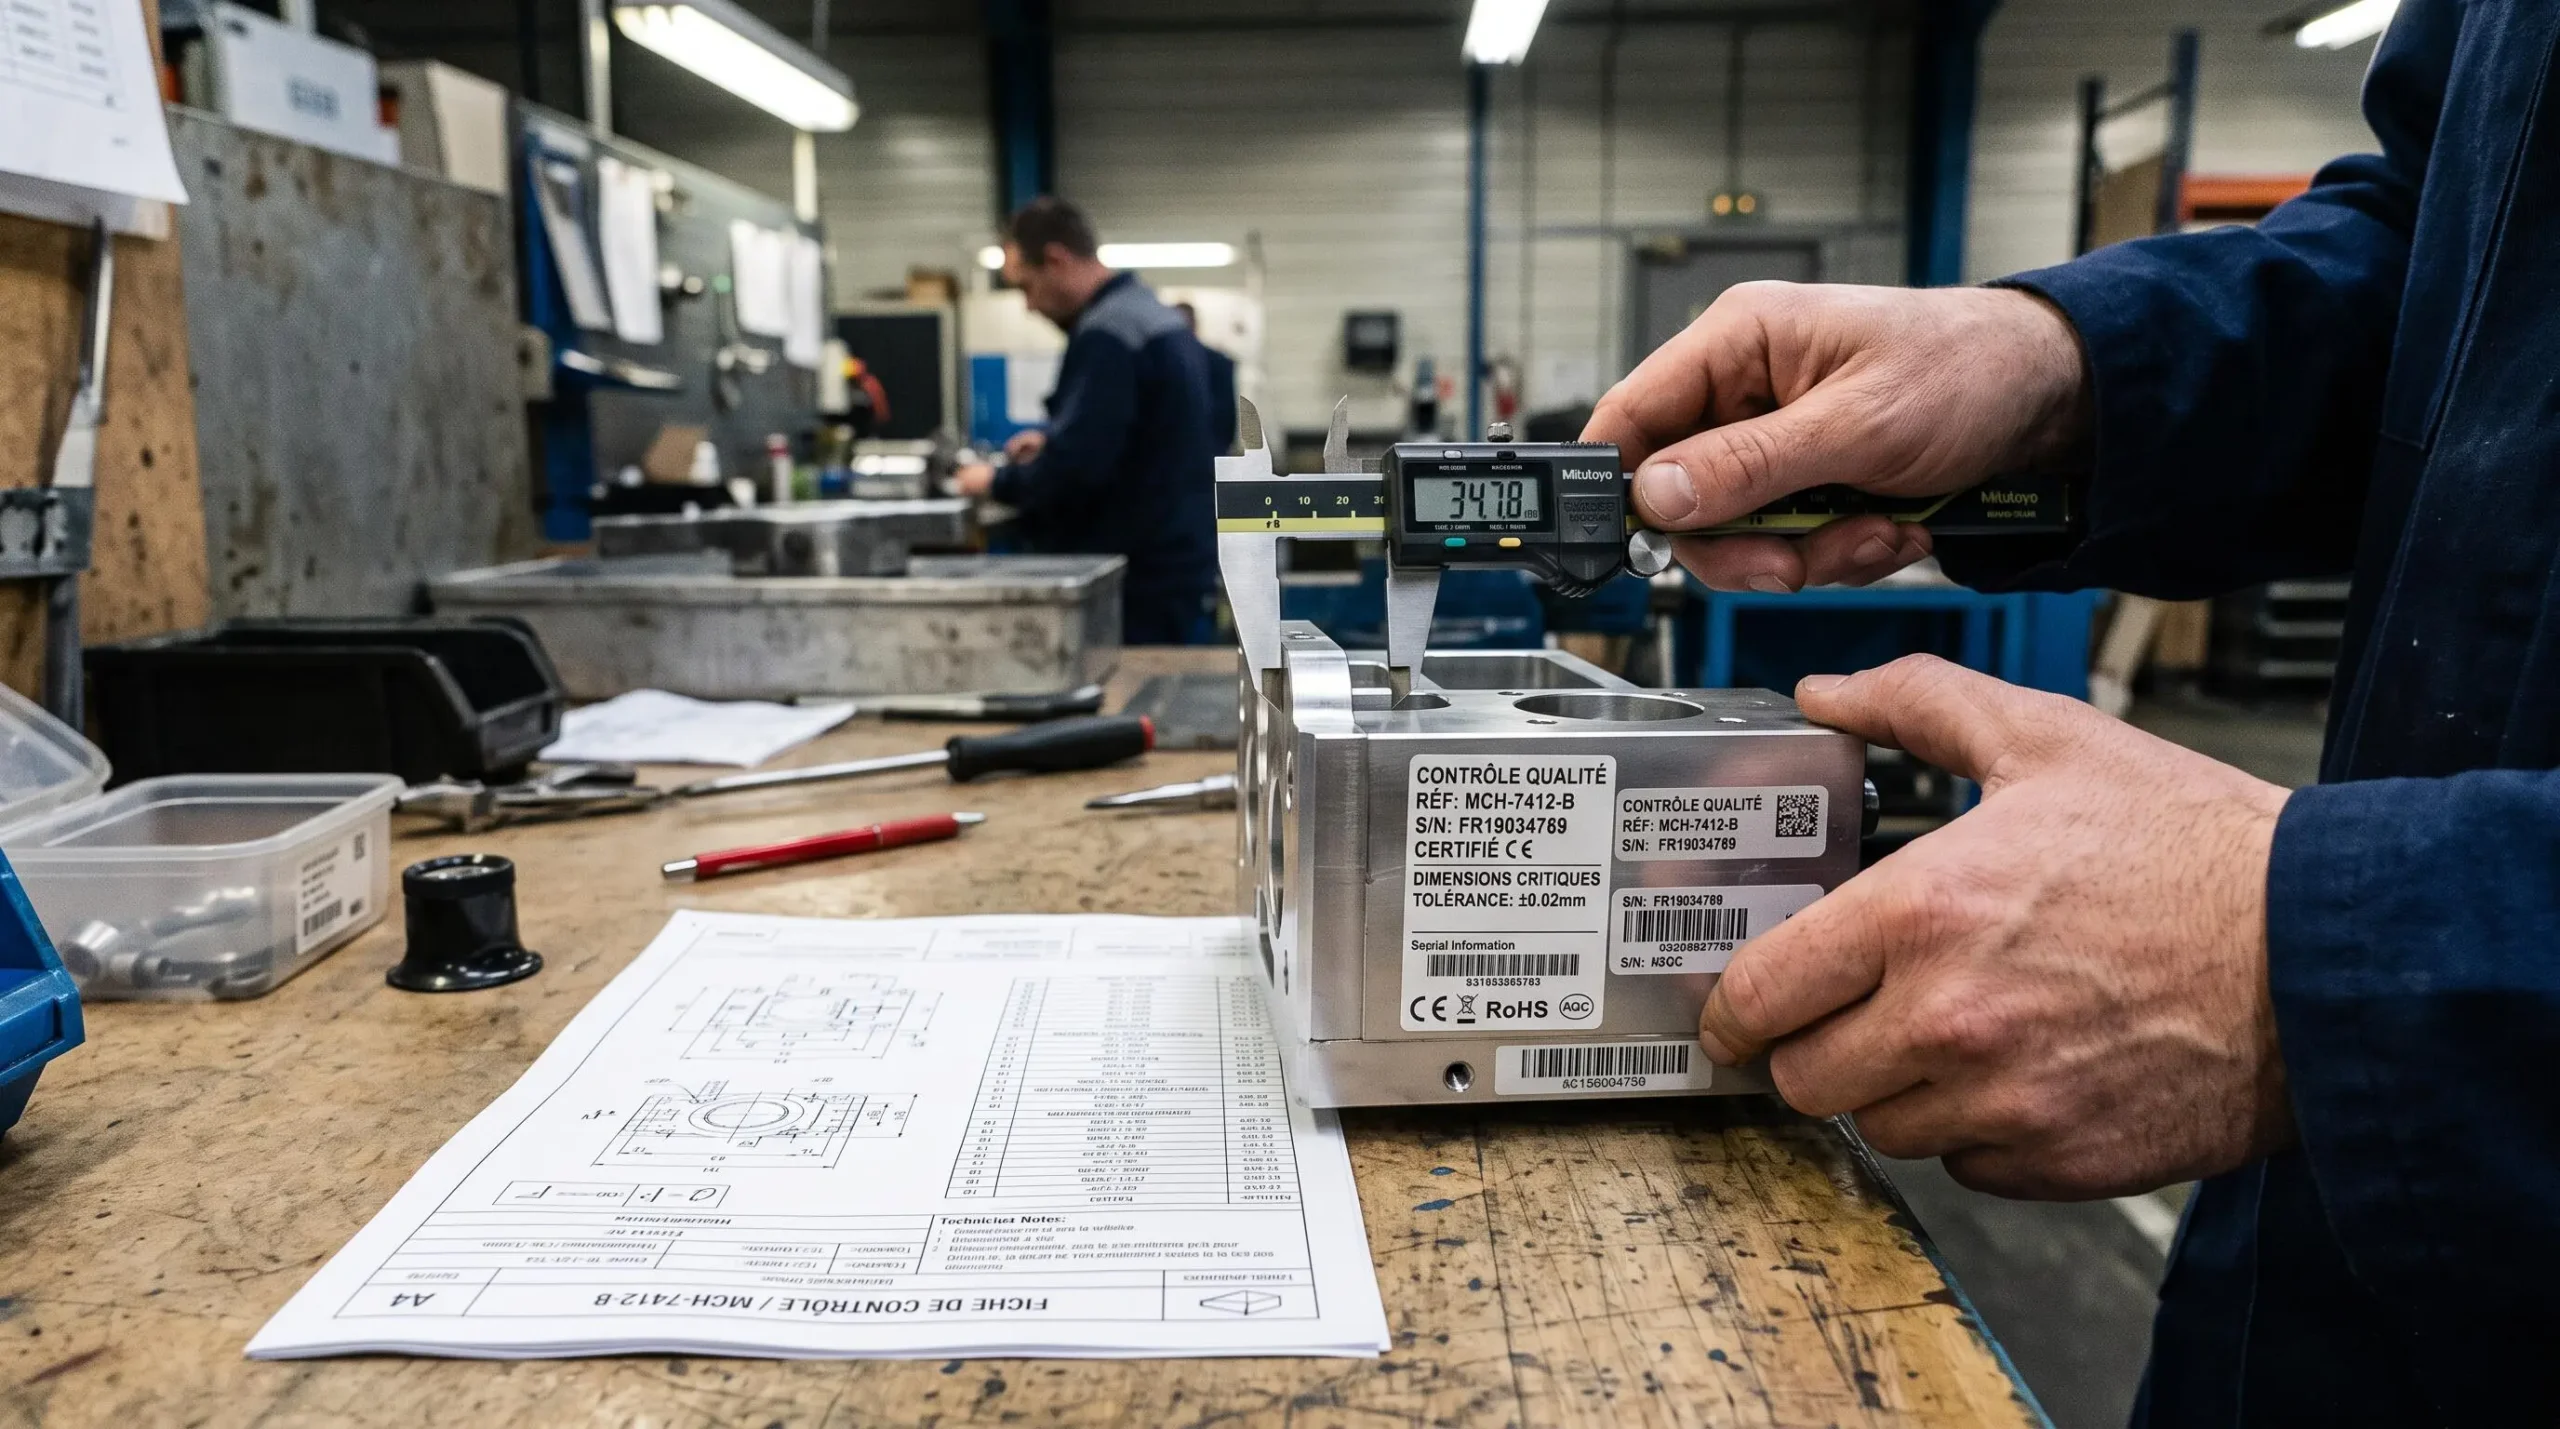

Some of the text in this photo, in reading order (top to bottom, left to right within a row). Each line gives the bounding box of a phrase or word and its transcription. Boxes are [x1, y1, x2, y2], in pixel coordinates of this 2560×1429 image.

[1562, 469, 1613, 482] Mitutoyo
[1265, 496, 1272, 505] 0
[1298, 496, 1311, 505] 10
[1336, 496, 1349, 505] 20
[1981, 491, 2039, 505] Mitutoyo
[1418, 763, 1606, 785] CONTRÔLE QUALITÉ
[1417, 788, 1574, 809] RÉF: MCH-7412-B
[1623, 795, 1762, 812] CONTRÔLE QUALITÉ
[1416, 817, 1451, 833] S/N:
[1623, 817, 1738, 832] RÉF: MCH-7412-B
[1415, 837, 1498, 857] CERTIFIÉ
[1623, 839, 1648, 851] S/N:
[1414, 872, 1600, 886] DIMENSIONS CRITIQUES
[1413, 889, 1585, 907] TOLÉRANCE: ±0.02mm
[1623, 896, 1646, 907] S/N:
[1452, 940, 1514, 950] Information
[1621, 957, 1644, 967] S/N:
[1487, 1001, 1547, 1018] RoHS
[390, 1292, 436, 1307] A4
[594, 1293, 754, 1309] MCH-7412-B
[778, 1297, 920, 1316] CONTRÔLE
[928, 1298, 963, 1312] DE
[970, 1298, 1048, 1311] FICHE
